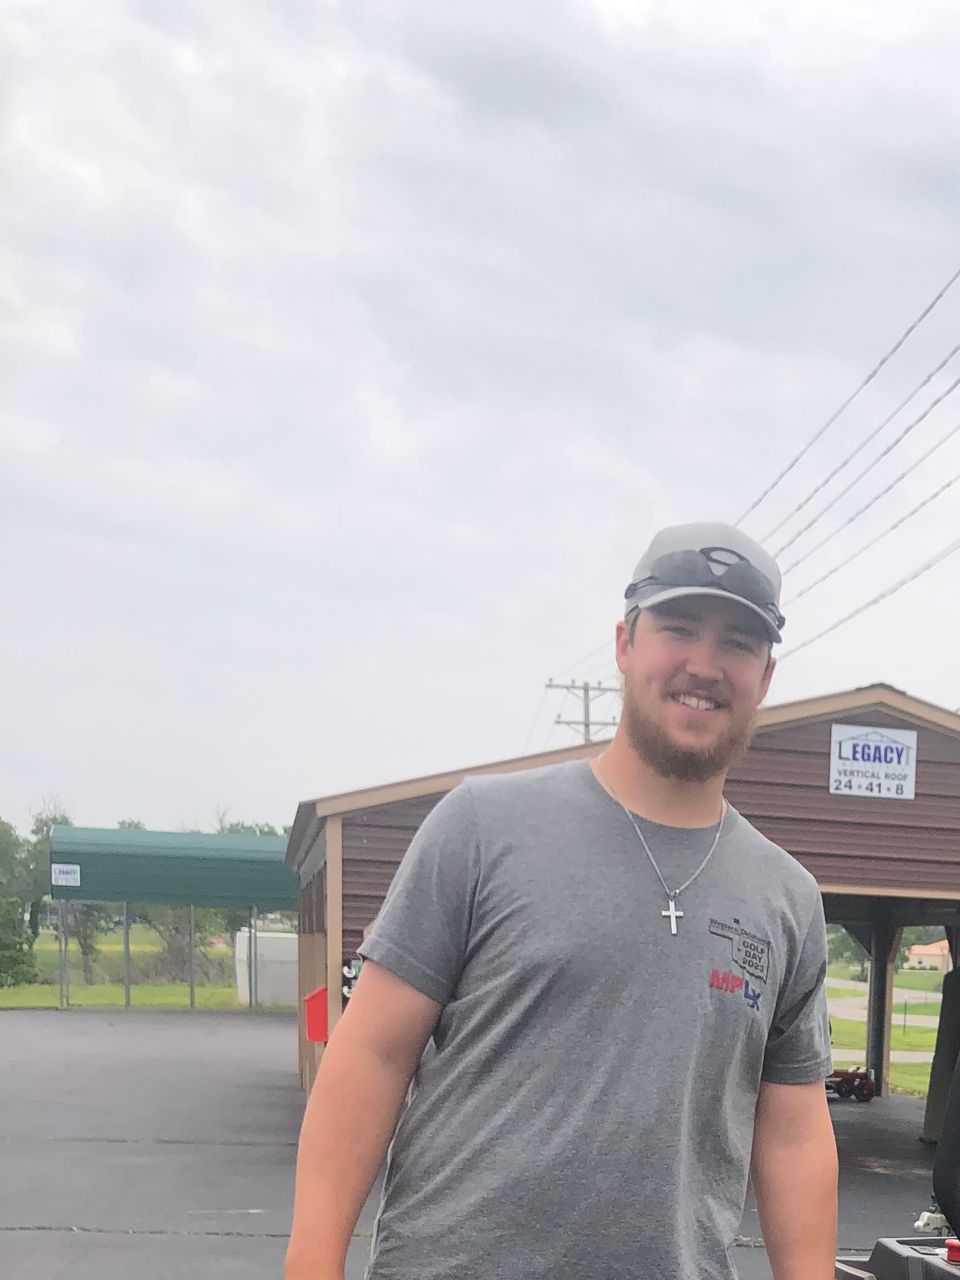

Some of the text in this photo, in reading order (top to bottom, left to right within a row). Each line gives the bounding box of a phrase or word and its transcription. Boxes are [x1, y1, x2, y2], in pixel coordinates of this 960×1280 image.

[838, 741, 904, 765] LEGACY
[837, 768, 908, 781] VERTICAL ROOF
[743, 941, 765, 955] GOLF
[745, 950, 762, 963] DAY
